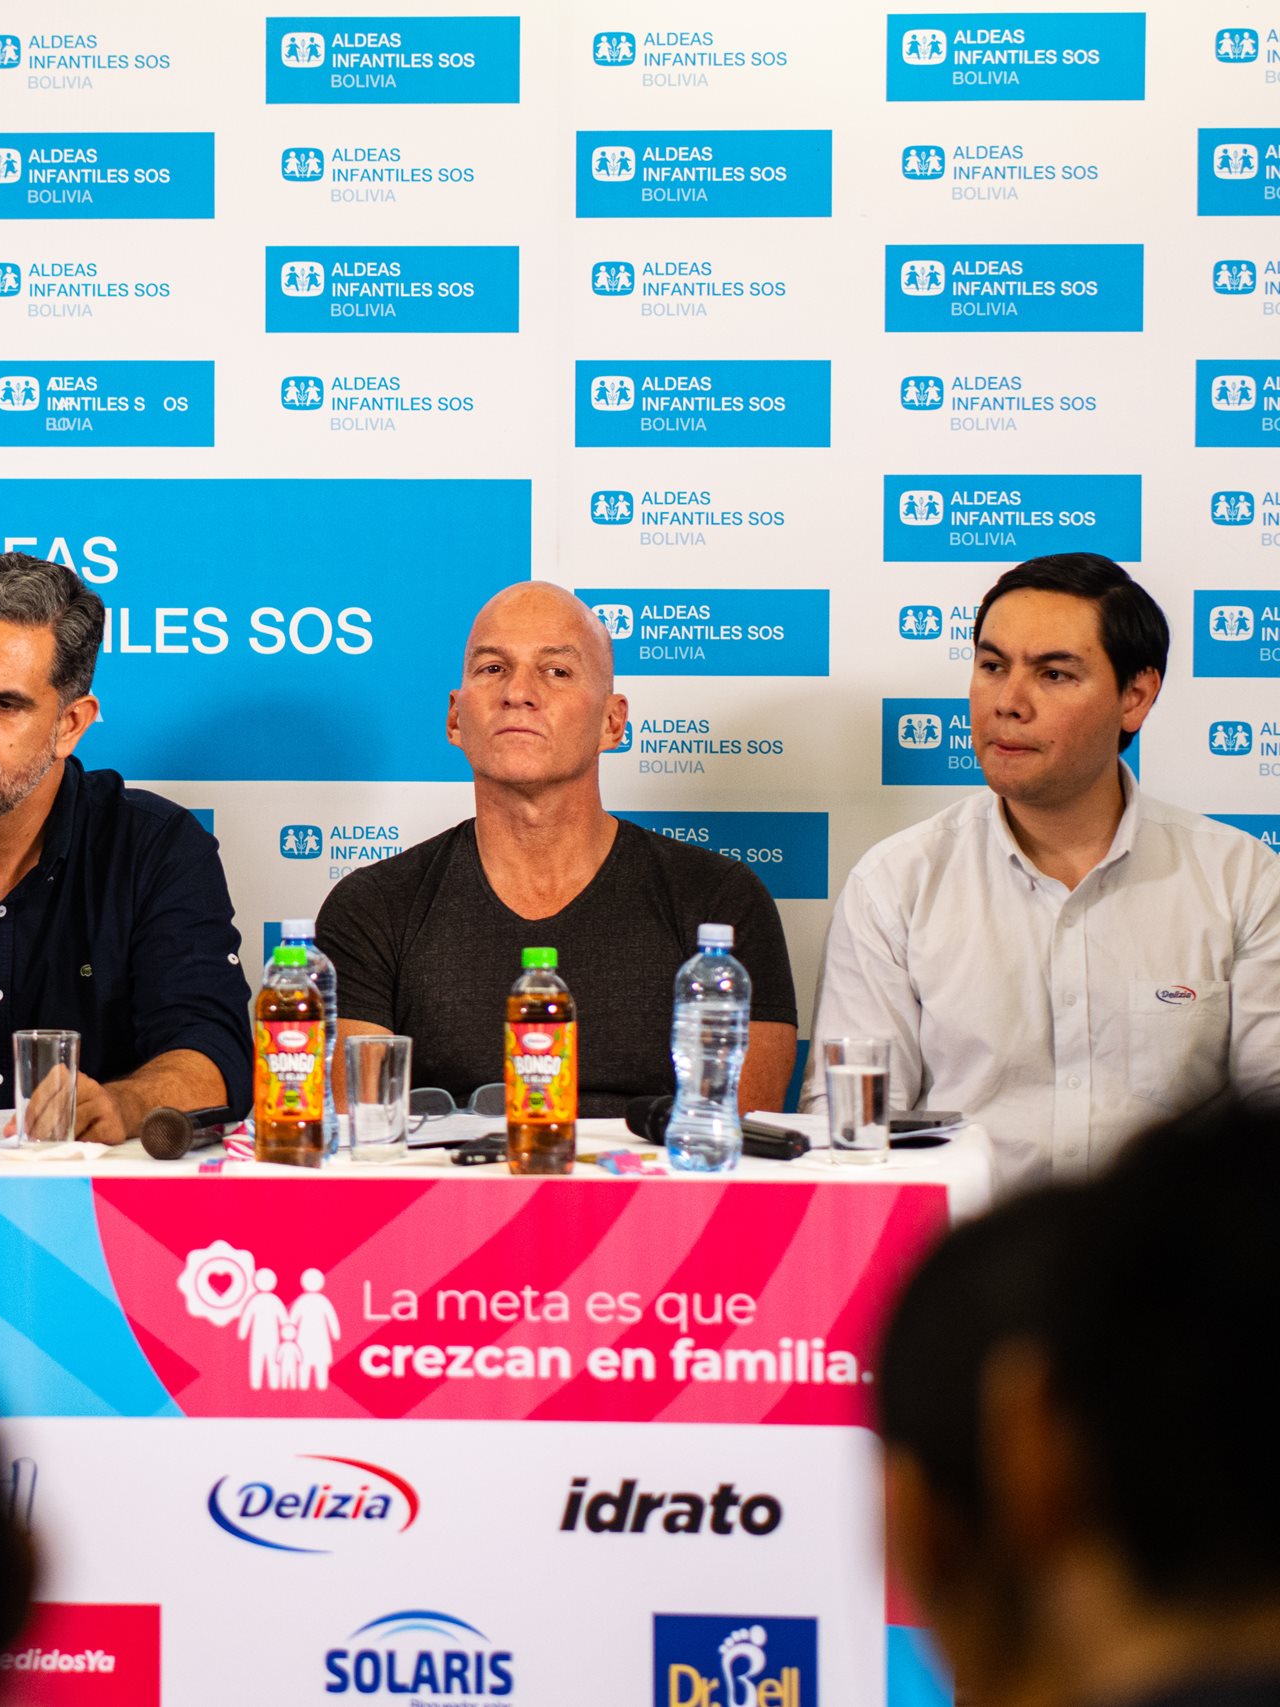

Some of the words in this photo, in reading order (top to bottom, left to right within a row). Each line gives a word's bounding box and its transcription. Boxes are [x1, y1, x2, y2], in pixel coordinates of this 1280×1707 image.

[332, 33, 401, 47] ALDEAS
[954, 29, 1024, 44] ALDEAS
[333, 53, 433, 68] INFANTILES
[439, 53, 475, 68] SOS
[955, 50, 1057, 64] INFANTILES
[1063, 50, 1099, 64] SOS
[331, 74, 396, 88] BOLIVIA
[953, 71, 1019, 84] BOLIVIA
[29, 149, 97, 163] ALDEAS
[643, 147, 712, 161] ALDEAS
[953, 146, 1023, 159] ALDEAS
[29, 169, 129, 183] INFANTILES
[134, 169, 170, 183] SOS
[644, 167, 744, 181] INFANTILES
[750, 167, 786, 181] SOS
[954, 166, 1055, 179] INFANTILES
[1062, 166, 1098, 179] SOS
[28, 190, 92, 203] BOLIVIA
[642, 188, 707, 201] BOLIVIA
[952, 187, 1018, 200] BOLIVIA
[332, 262, 400, 276] ALDEAS
[953, 261, 1023, 275] ALDEAS
[332, 282, 432, 297] INFANTILES
[438, 282, 474, 297] SOS
[953, 281, 1055, 295] INFANTILES
[1061, 281, 1098, 295] SOS
[331, 304, 396, 316] BOLIVIA
[952, 302, 1017, 316] BOLIVIA
[642, 377, 711, 391] ALDEAS
[643, 397, 743, 411] INFANTILES
[749, 397, 785, 411] SOS
[641, 418, 706, 431] BOLIVIA
[951, 491, 1021, 505] ALDEAS
[952, 512, 1053, 526] INFANTILES
[1059, 512, 1095, 526] SOS
[950, 532, 1016, 545] BOLIVIA
[641, 605, 710, 619] ALDEAS
[249, 607, 373, 654] SOS
[642, 626, 742, 640] INFANTILES
[748, 626, 784, 640] SOS
[640, 646, 705, 659] BOLIVIA
[330, 826, 399, 840] ALDEAS
[747, 849, 783, 862] SOS
[268, 1052, 316, 1074] BONGO
[513, 1055, 561, 1075] BONGO
[363, 1281, 419, 1322] La
[436, 1284, 570, 1323] meta
[585, 1291, 643, 1324] es
[655, 1291, 757, 1333] que
[359, 1344, 572, 1379] crezcan
[586, 1346, 656, 1381] en
[670, 1337, 875, 1385] familia.
[237, 1481, 393, 1519] Delizia
[559, 1476, 783, 1536] idrato
[325, 1649, 515, 1696] SOLARIS
[669, 1663, 722, 1707] Dr.
